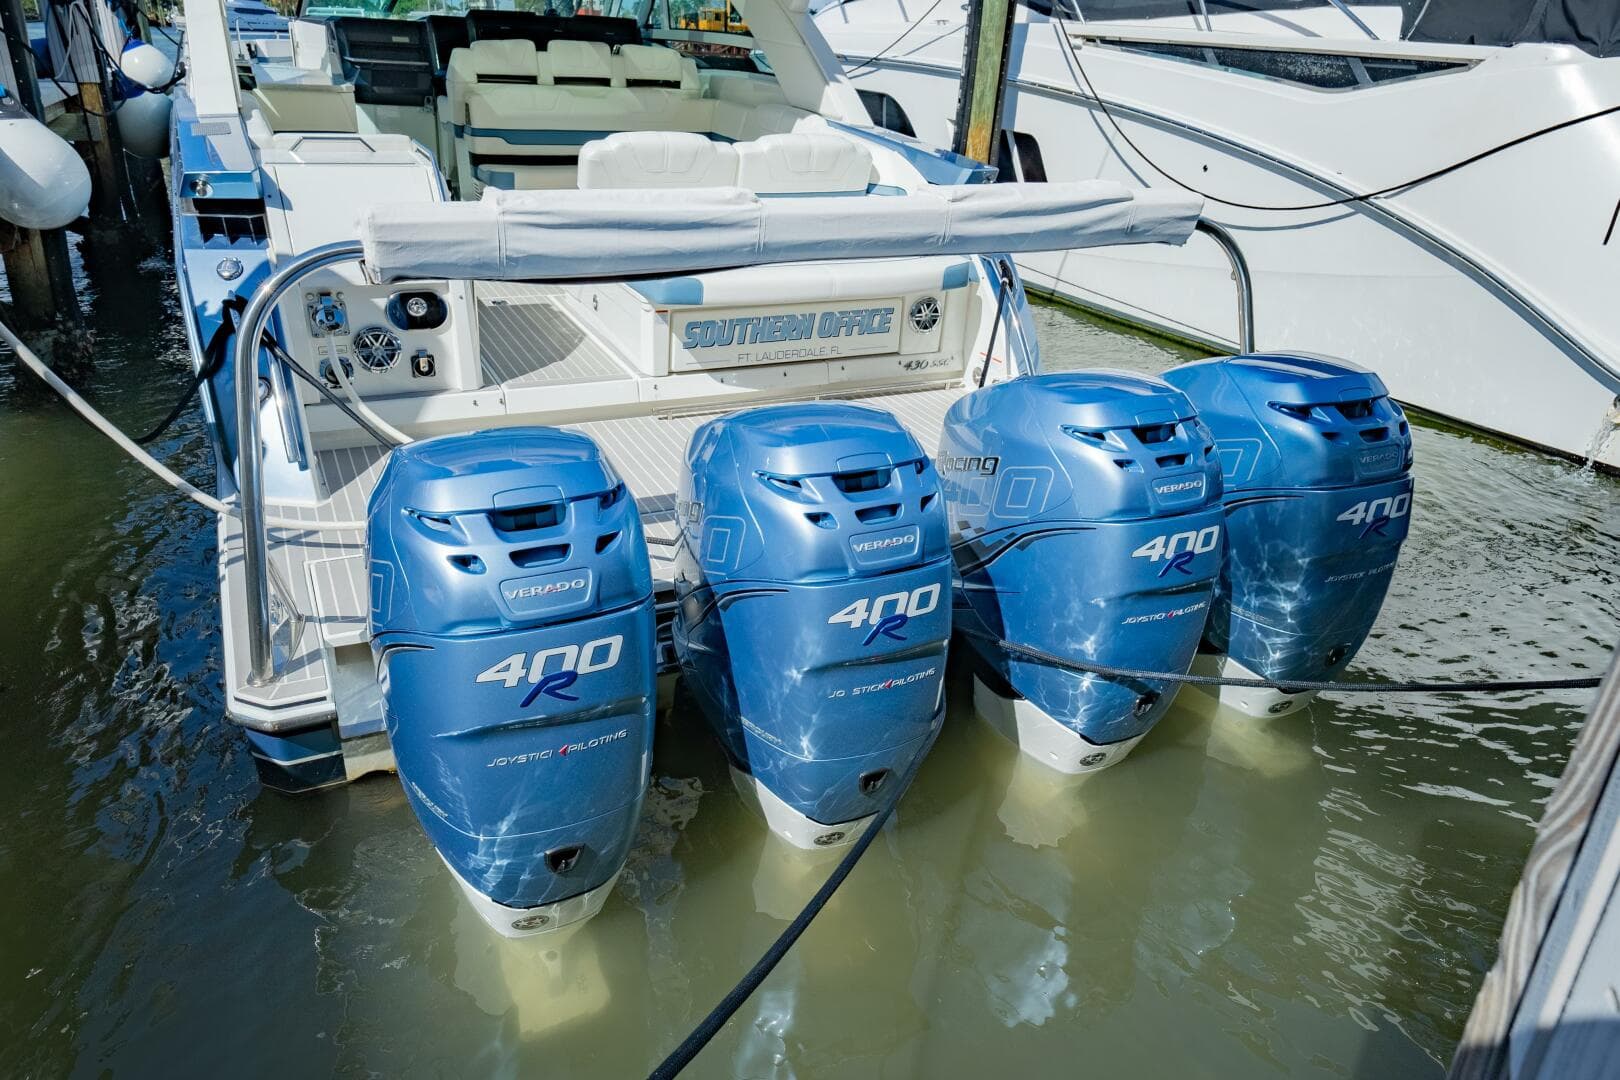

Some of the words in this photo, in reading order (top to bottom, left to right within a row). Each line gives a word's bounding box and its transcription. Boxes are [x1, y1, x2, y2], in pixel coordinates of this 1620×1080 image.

[682, 313, 816, 350] SOUTHERN
[817, 307, 895, 339] OFFICE
[831, 345, 842, 355] FL
[903, 359, 929, 371] 430
[1360, 451, 1399, 464] VERADO
[1154, 479, 1203, 495] VERADO
[1336, 492, 1412, 526] 400
[1358, 515, 1389, 540] R
[852, 534, 915, 553] VERADO
[1131, 525, 1220, 562] 400
[1157, 551, 1195, 578] R
[504, 578, 586, 600] VERADO
[828, 582, 941, 629] 400
[862, 613, 908, 647] R
[475, 634, 624, 689] 400
[519, 669, 580, 709] R
[889, 667, 937, 688] PILOTING
[566, 729, 628, 754] PILOTING
